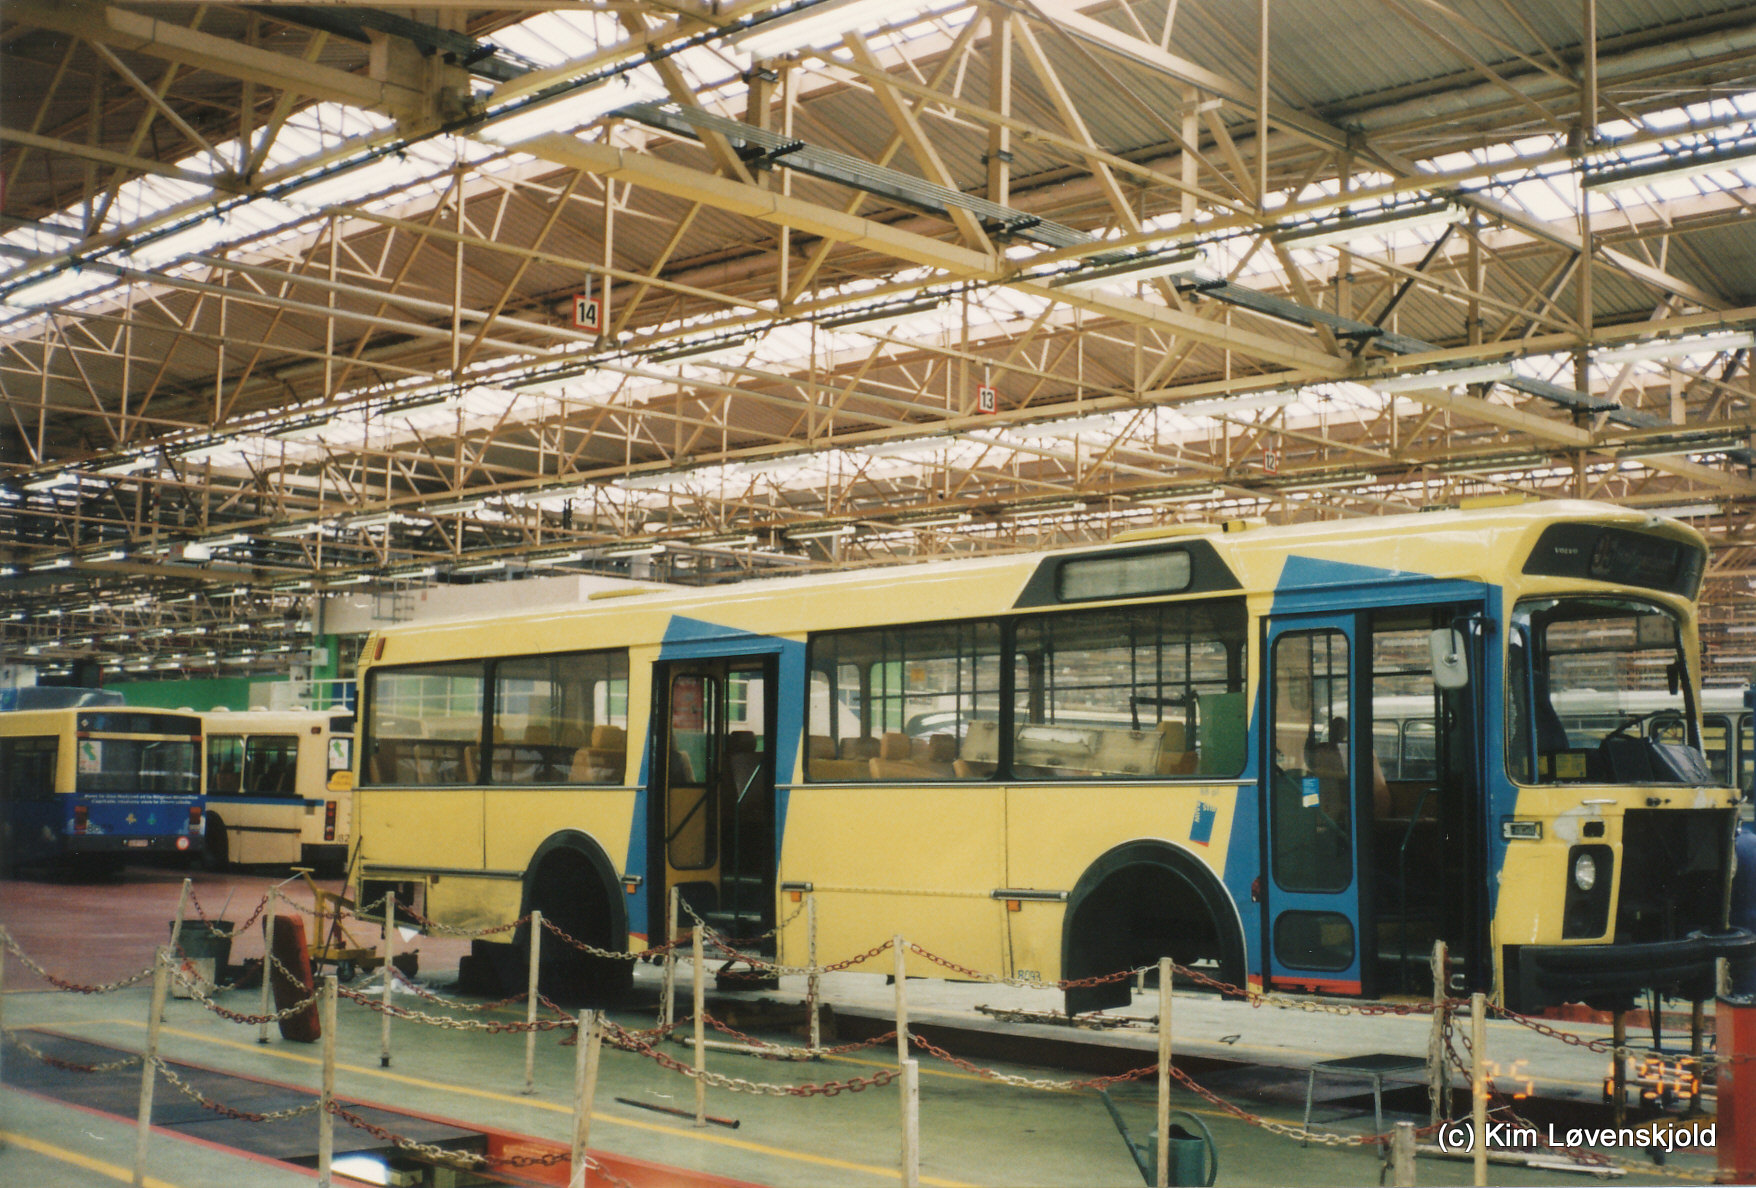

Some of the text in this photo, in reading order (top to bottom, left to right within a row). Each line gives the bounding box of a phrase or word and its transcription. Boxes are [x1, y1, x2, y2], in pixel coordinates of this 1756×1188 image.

[578, 301, 596, 325] 14
[981, 390, 993, 409] 13
[1266, 454, 1275, 470] 12
